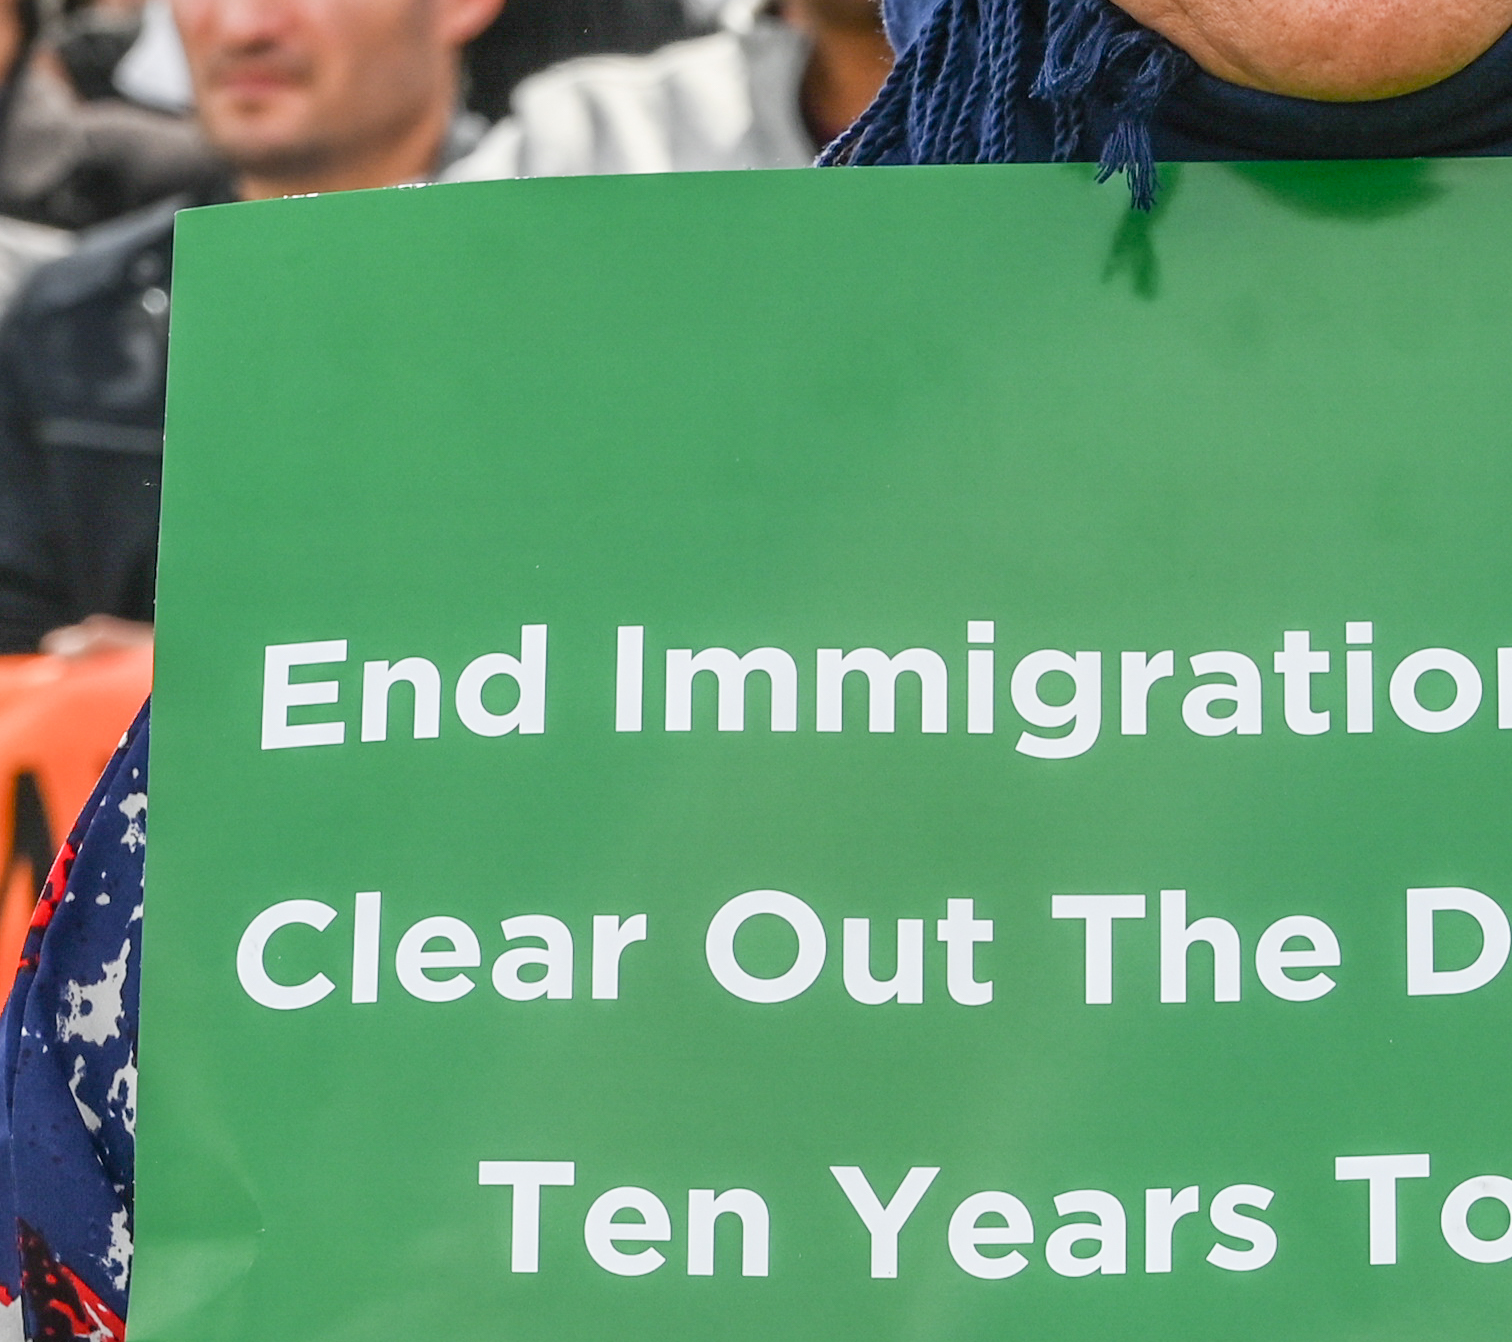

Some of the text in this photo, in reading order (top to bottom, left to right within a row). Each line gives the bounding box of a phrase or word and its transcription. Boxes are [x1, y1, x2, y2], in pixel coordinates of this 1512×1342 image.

[260, 623, 549, 751] End
[235, 890, 648, 1011] Clear
[704, 888, 995, 1007] Out
[1050, 888, 1342, 1006] The
[477, 1159, 771, 1278] Ten
[828, 1165, 1278, 1281] Years
